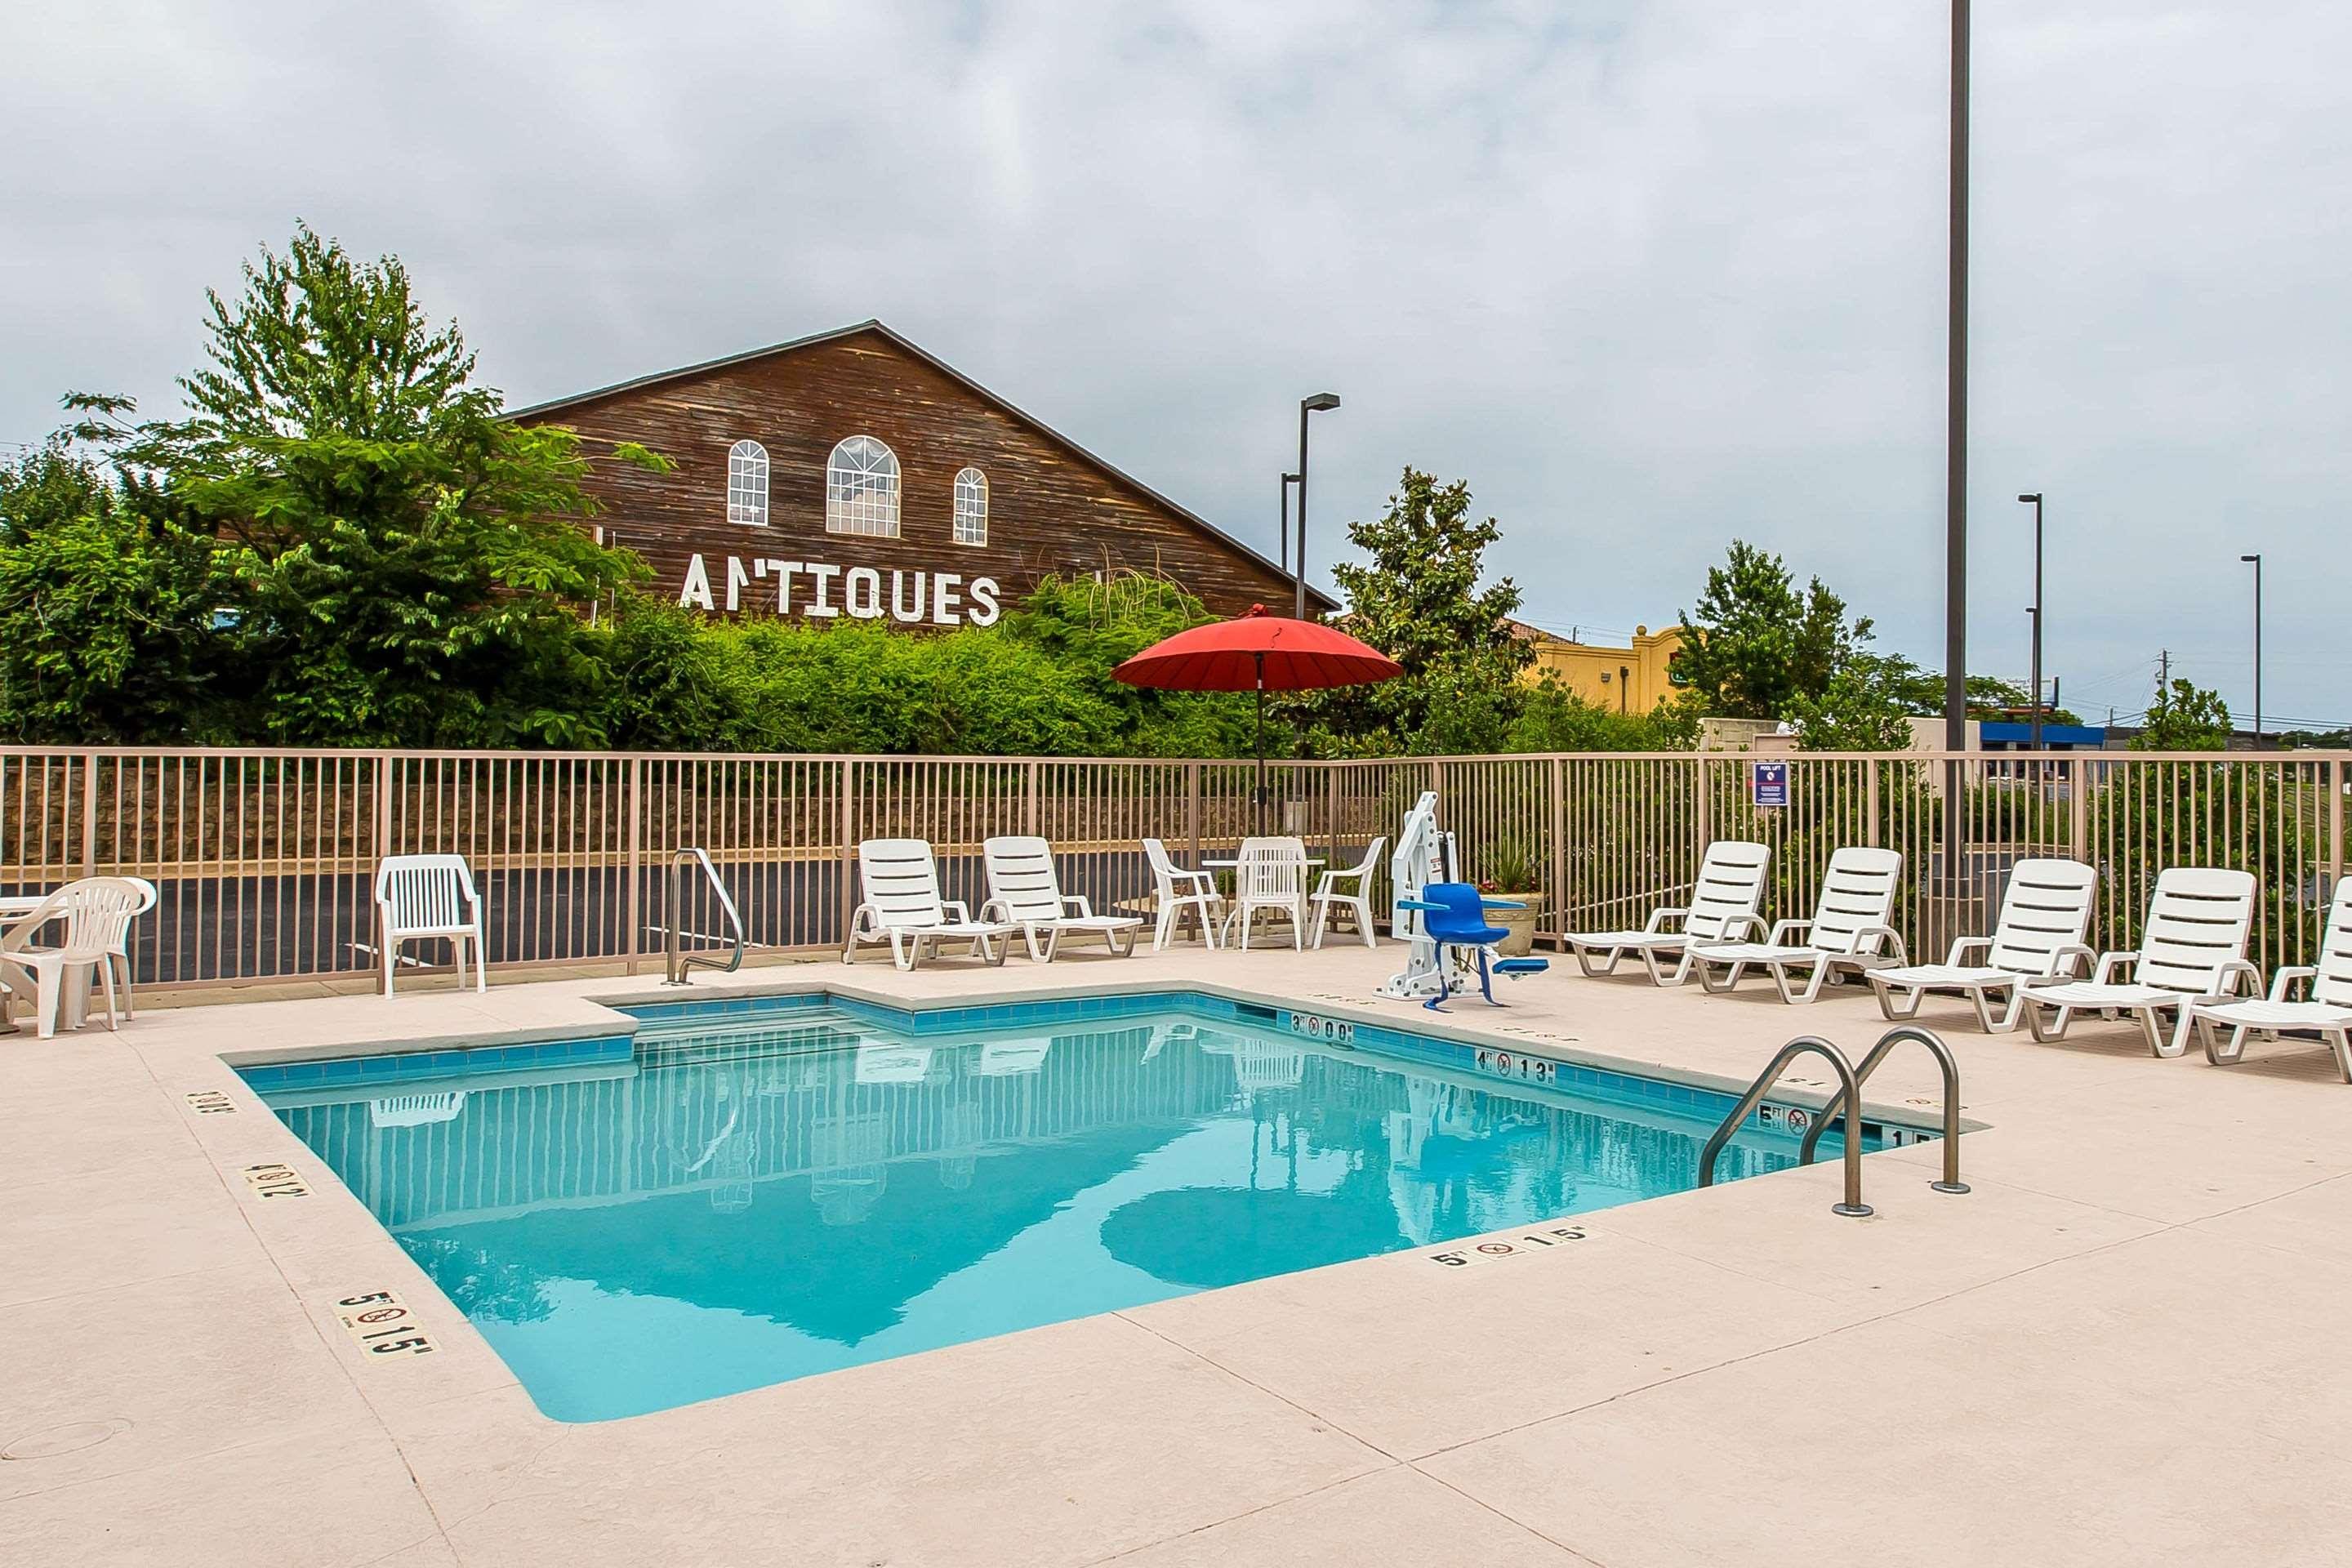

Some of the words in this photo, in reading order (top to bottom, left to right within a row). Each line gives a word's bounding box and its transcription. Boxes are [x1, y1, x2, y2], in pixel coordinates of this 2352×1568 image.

[679, 554, 1000, 626] ANTIQUES
[1772, 1107, 1781, 1117] FT
[1430, 1254, 1468, 1267] 5
[339, 1291, 391, 1306] 5
